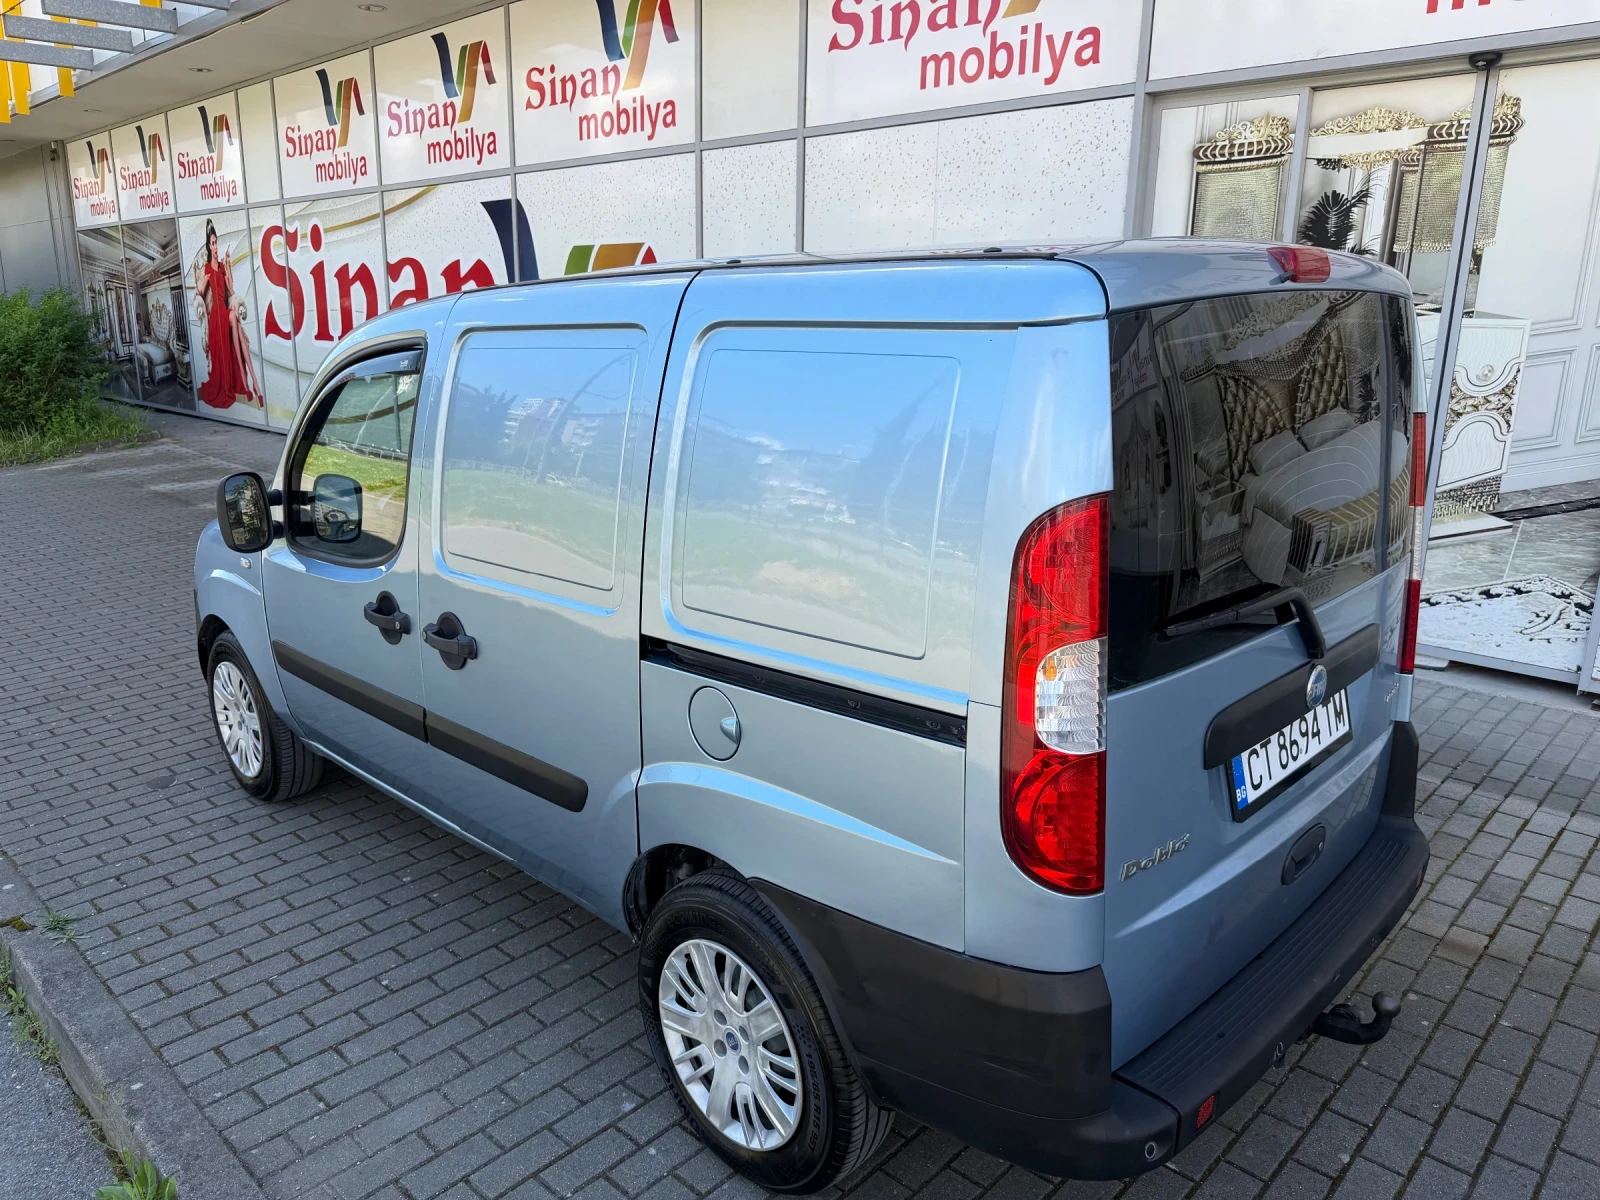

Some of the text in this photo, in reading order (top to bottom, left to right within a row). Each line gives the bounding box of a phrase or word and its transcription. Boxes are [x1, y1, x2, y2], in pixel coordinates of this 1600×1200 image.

[828, 0, 1001, 53] Sinan
[919, 22, 1102, 90] mobilya
[525, 64, 622, 112] Sinan
[387, 99, 457, 139] Sinan
[578, 96, 677, 141] mobilya
[285, 126, 337, 159] Sinan
[427, 127, 497, 165] mobilya
[120, 167, 151, 193] Sinan
[177, 152, 216, 181] Sinan
[316, 152, 368, 184] mobilya
[73, 177, 100, 201] Sinan
[139, 189, 169, 212] mobilya
[200, 175, 238, 203] mobilya
[90, 198, 116, 218] mobilya
[1247, 738, 1272, 791] CT
[1277, 709, 1321, 770] 8694
[1321, 690, 1346, 737] TM
[1236, 786, 1246, 802] BG
[805, 1052, 821, 1102] 195/65
[812, 1103, 822, 1130] R15
